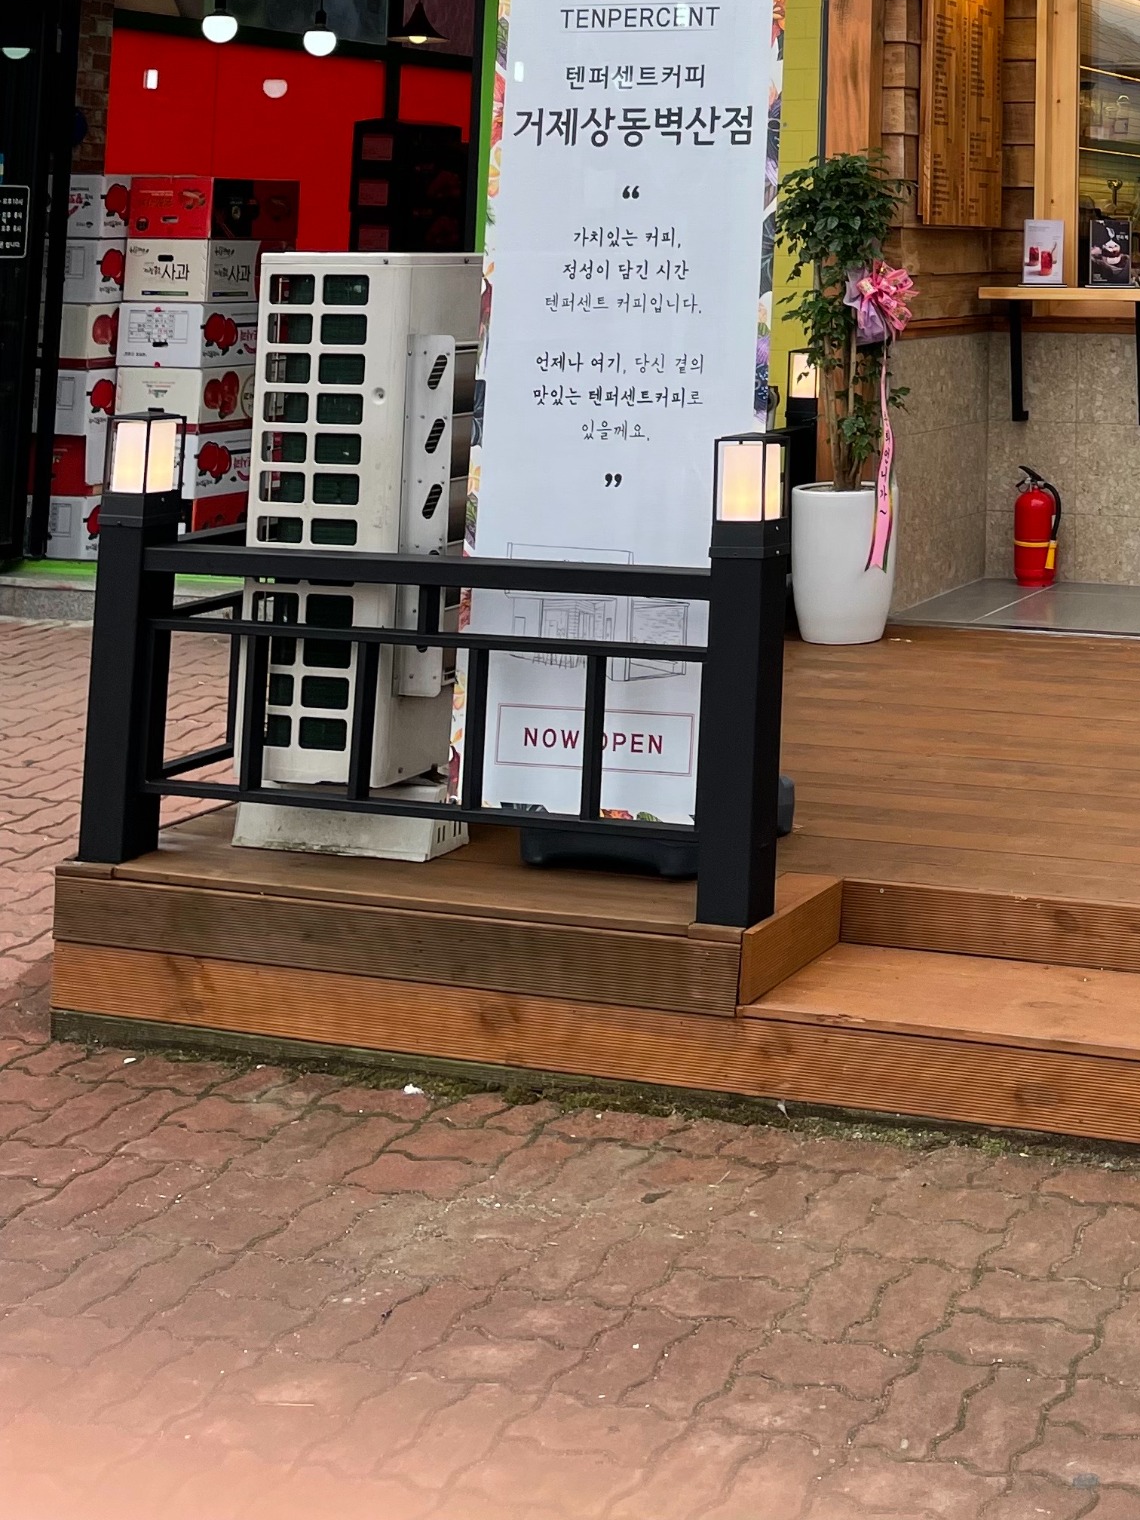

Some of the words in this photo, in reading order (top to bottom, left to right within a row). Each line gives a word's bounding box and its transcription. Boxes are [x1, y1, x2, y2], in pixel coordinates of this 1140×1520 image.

[560, 6, 721, 30] TENPERCENT
[566, 64, 706, 91] 텐퍼센트커피
[513, 104, 754, 148] 거제상동벽산점
[573, 227, 638, 248] 가치있는
[645, 226, 682, 249] 커피,
[562, 259, 610, 280] 정성이
[618, 259, 649, 280] 담긴
[656, 259, 689, 280] 시간
[545, 292, 609, 313] 텐퍼센트
[616, 292, 702, 314] 커피입니다.
[535, 351, 584, 373] 언제나
[590, 352, 627, 375] 여기,
[634, 352, 666, 374] 당신
[533, 384, 581, 406] 맛있는
[588, 385, 703, 408] 텐퍼센트커피로
[523, 727, 580, 749] NOW
